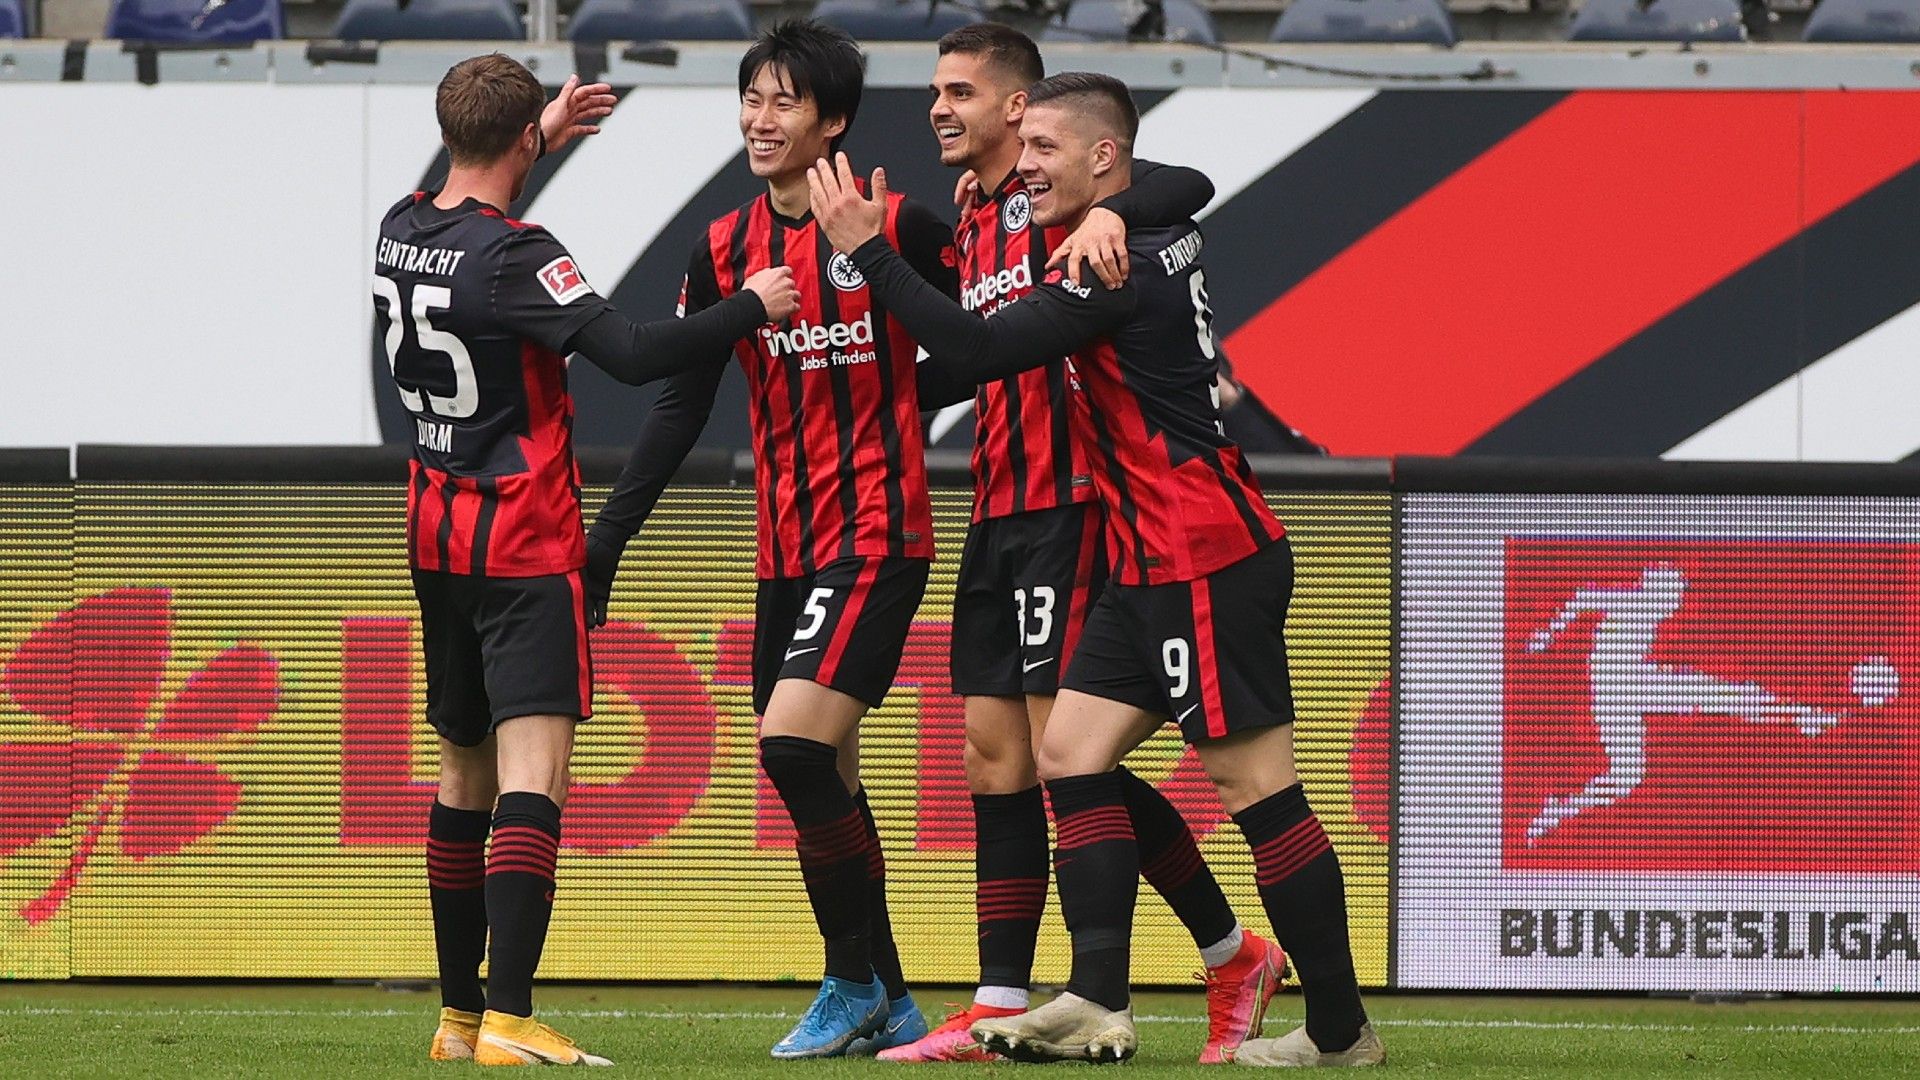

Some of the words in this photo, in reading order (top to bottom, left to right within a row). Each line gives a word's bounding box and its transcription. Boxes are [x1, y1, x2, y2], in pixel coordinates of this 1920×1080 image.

[377, 237, 466, 277] EINTRACHT
[961, 253, 1033, 312] indeed
[372, 273, 480, 418] 25
[761, 310, 874, 358] indeed
[799, 354, 829, 371] Jobs
[830, 349, 877, 366] finden
[792, 587, 835, 642] 5
[1161, 637, 1191, 699] 9
[340, 616, 1242, 855] LOT
[1499, 908, 1920, 962] BUNDESLIGA
